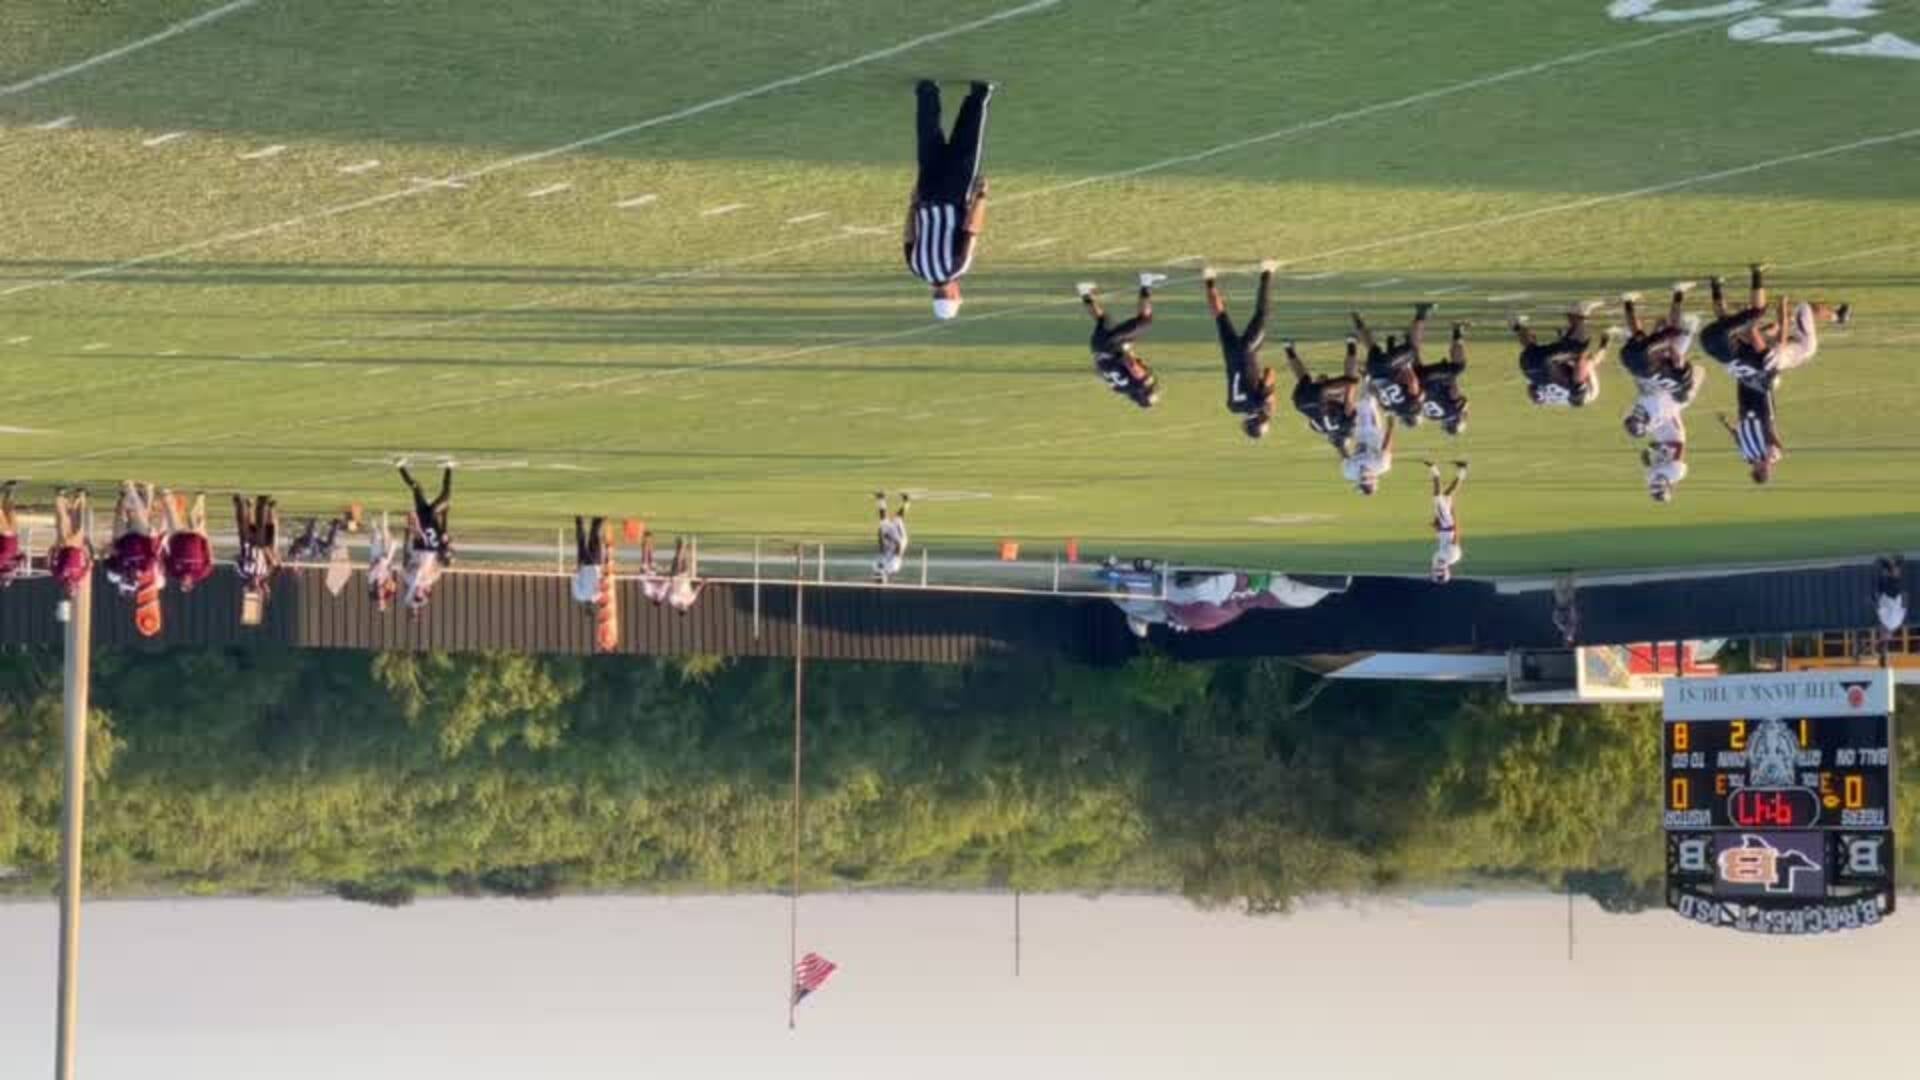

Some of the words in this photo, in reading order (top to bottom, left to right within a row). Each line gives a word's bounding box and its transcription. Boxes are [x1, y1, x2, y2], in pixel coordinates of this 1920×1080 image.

[1232, 371, 1248, 402] 7
[1672, 722, 1689, 750] 8
[1728, 719, 1746, 749] 2
[1835, 748, 1856, 767] ON
[1858, 747, 1888, 766] BALL
[1671, 776, 1689, 810] 0
[1844, 774, 1863, 809] 0
[1738, 792, 1792, 825] 9:47
[1678, 839, 1706, 870] B
[1849, 839, 1878, 873] B
